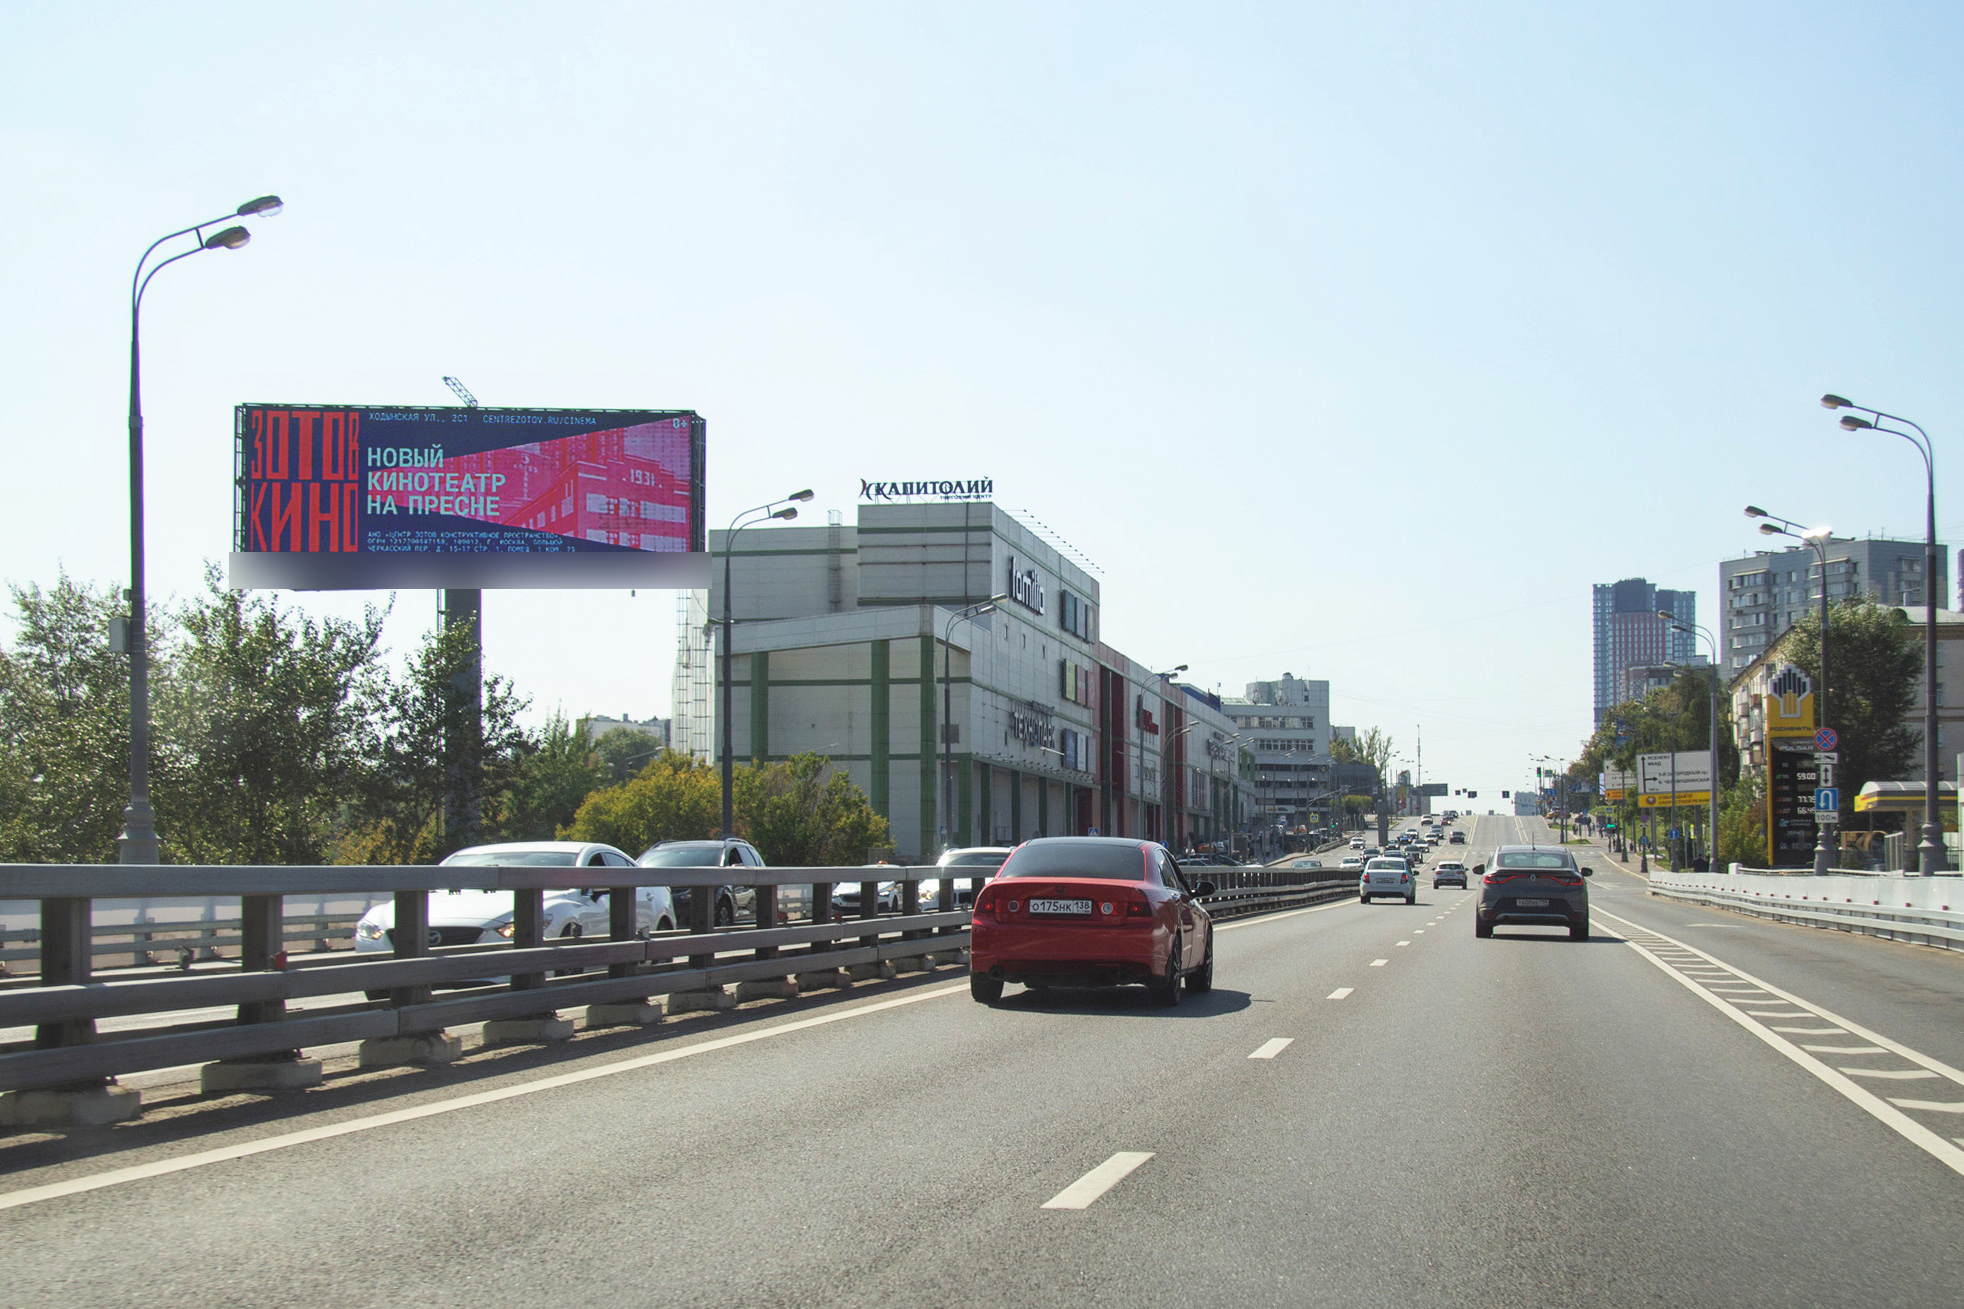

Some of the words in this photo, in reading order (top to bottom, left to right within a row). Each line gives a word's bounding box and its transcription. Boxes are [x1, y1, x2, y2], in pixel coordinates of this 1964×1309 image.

[368, 412, 420, 421] ХОДЫНСКАЯ
[482, 414, 597, 425] CENTREZOTOV.RU/CINEMA
[672, 417, 688, 429] 0+
[251, 410, 360, 481] ЗОТОВ
[367, 443, 444, 468] НОВЫЙ
[367, 471, 506, 493] КИНОТЕАТР
[874, 475, 994, 501] КАПИТОЛИЙ
[367, 494, 398, 515] НА
[408, 495, 500, 517] ПРЕСНЕ
[250, 482, 359, 552] КИНО
[1031, 901, 1072, 912] О175НК
[1074, 901, 1090, 910] 138
